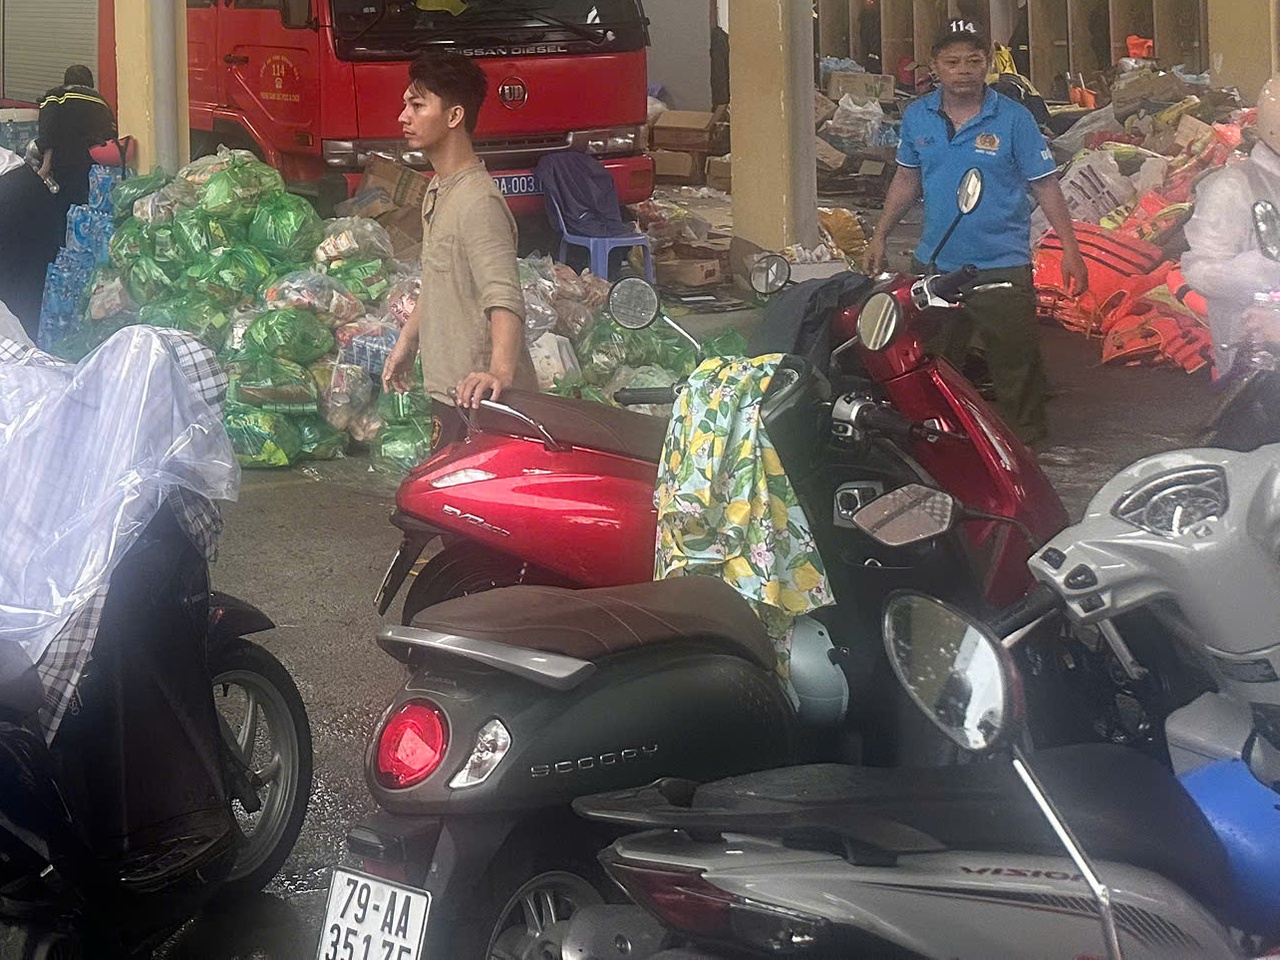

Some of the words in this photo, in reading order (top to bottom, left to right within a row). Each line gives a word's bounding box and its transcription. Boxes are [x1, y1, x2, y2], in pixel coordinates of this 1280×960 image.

[950, 19, 977, 33] 114
[511, 44, 568, 56] DIESEL
[272, 64, 285, 77] 114
[503, 85, 525, 101] UD
[530, 744, 658, 778] SCOOPY
[340, 877, 412, 940] 79-AA
